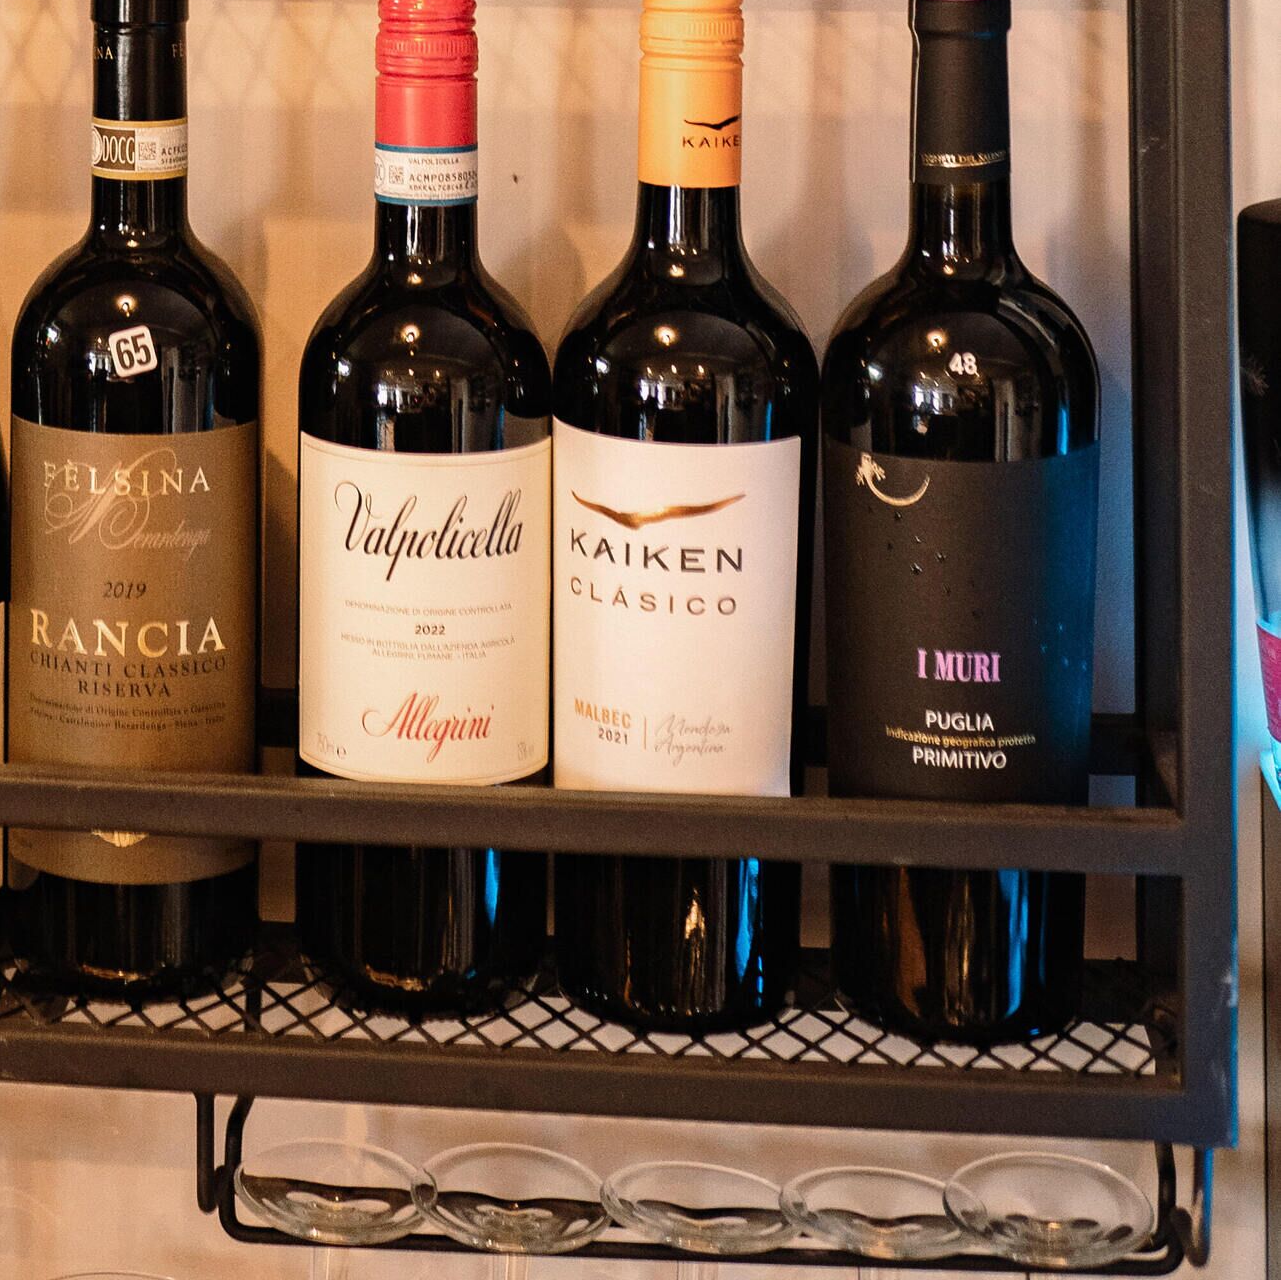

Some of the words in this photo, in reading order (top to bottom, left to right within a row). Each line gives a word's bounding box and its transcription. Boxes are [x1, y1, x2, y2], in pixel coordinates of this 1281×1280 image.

[101, 134, 135, 164] DOCG
[117, 332, 152, 371] 65
[949, 351, 978, 376] 48
[43, 458, 212, 496] FÈLSINA
[334, 481, 524, 583] Valpolicella
[571, 527, 743, 574] KAIKEN
[102, 581, 148, 600] 2019
[570, 576, 738, 617] CLÁSICO
[422, 606, 457, 616] ORIGINE
[29, 608, 228, 657] RANCIA
[414, 624, 446, 636] 2022
[29, 651, 113, 677] CHIANTI
[123, 655, 228, 679] CLASSICO
[461, 650, 487, 660] ITALIA
[917, 647, 929, 680] I
[934, 649, 1002, 683] MURI
[77, 679, 173, 698] RISERVA
[574, 696, 632, 730] MALBEC
[925, 708, 996, 733] PUGLIA
[361, 692, 495, 765] Allegrini
[598, 727, 629, 745] 2021
[885, 724, 942, 747] Indicazione
[943, 733, 997, 749] geografica
[998, 733, 1037, 748] protetta
[912, 746, 1008, 770] PRIMITIVO
